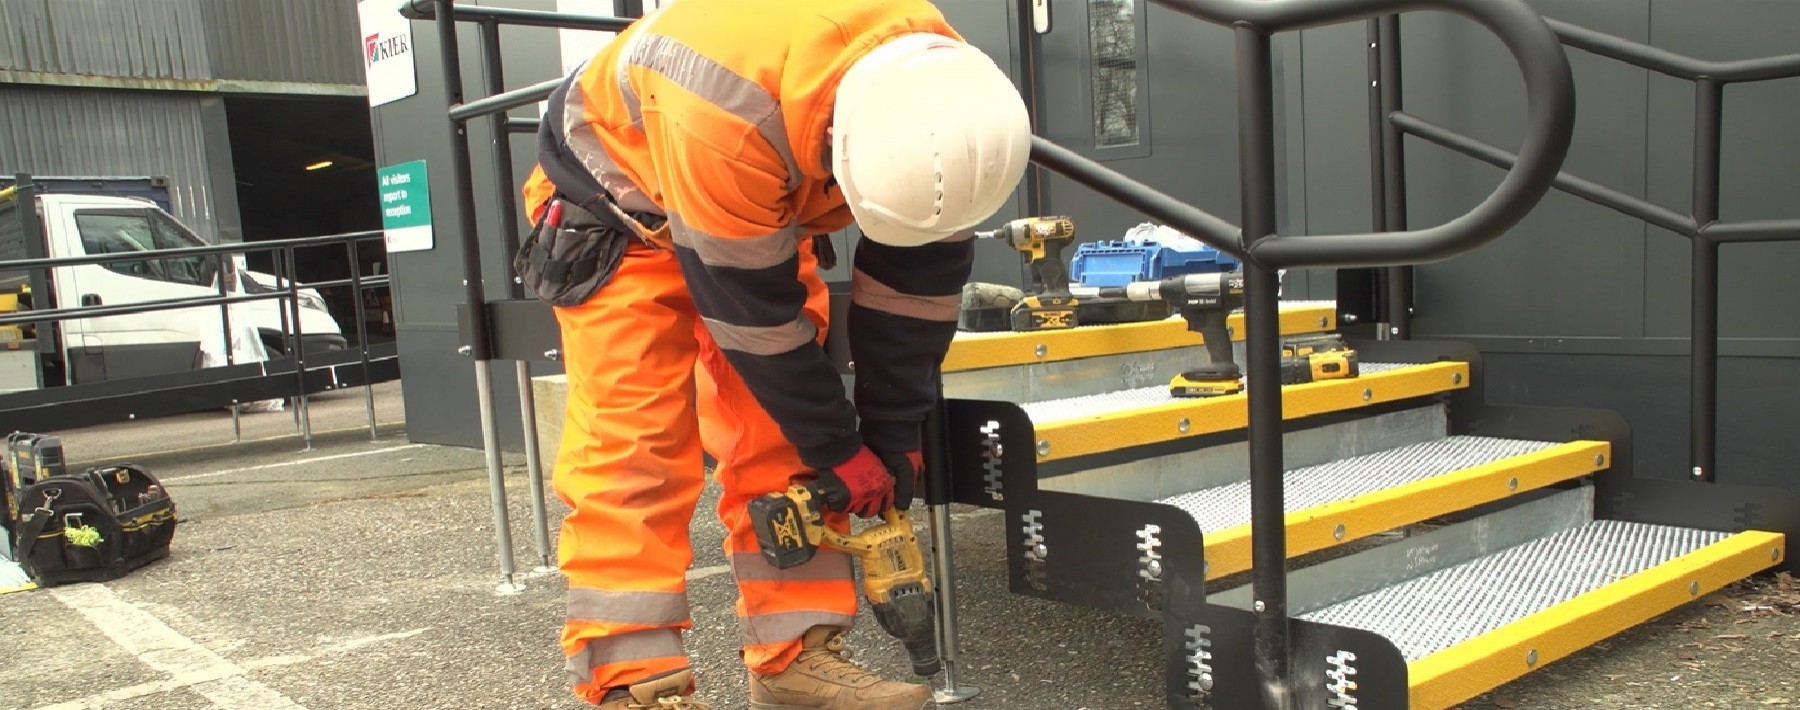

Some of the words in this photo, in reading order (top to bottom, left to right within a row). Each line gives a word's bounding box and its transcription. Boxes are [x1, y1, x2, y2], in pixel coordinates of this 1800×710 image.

[380, 34, 409, 60] KIER
[390, 173, 411, 185] visitors
[384, 190, 401, 203] report
[386, 205, 412, 218] reception
